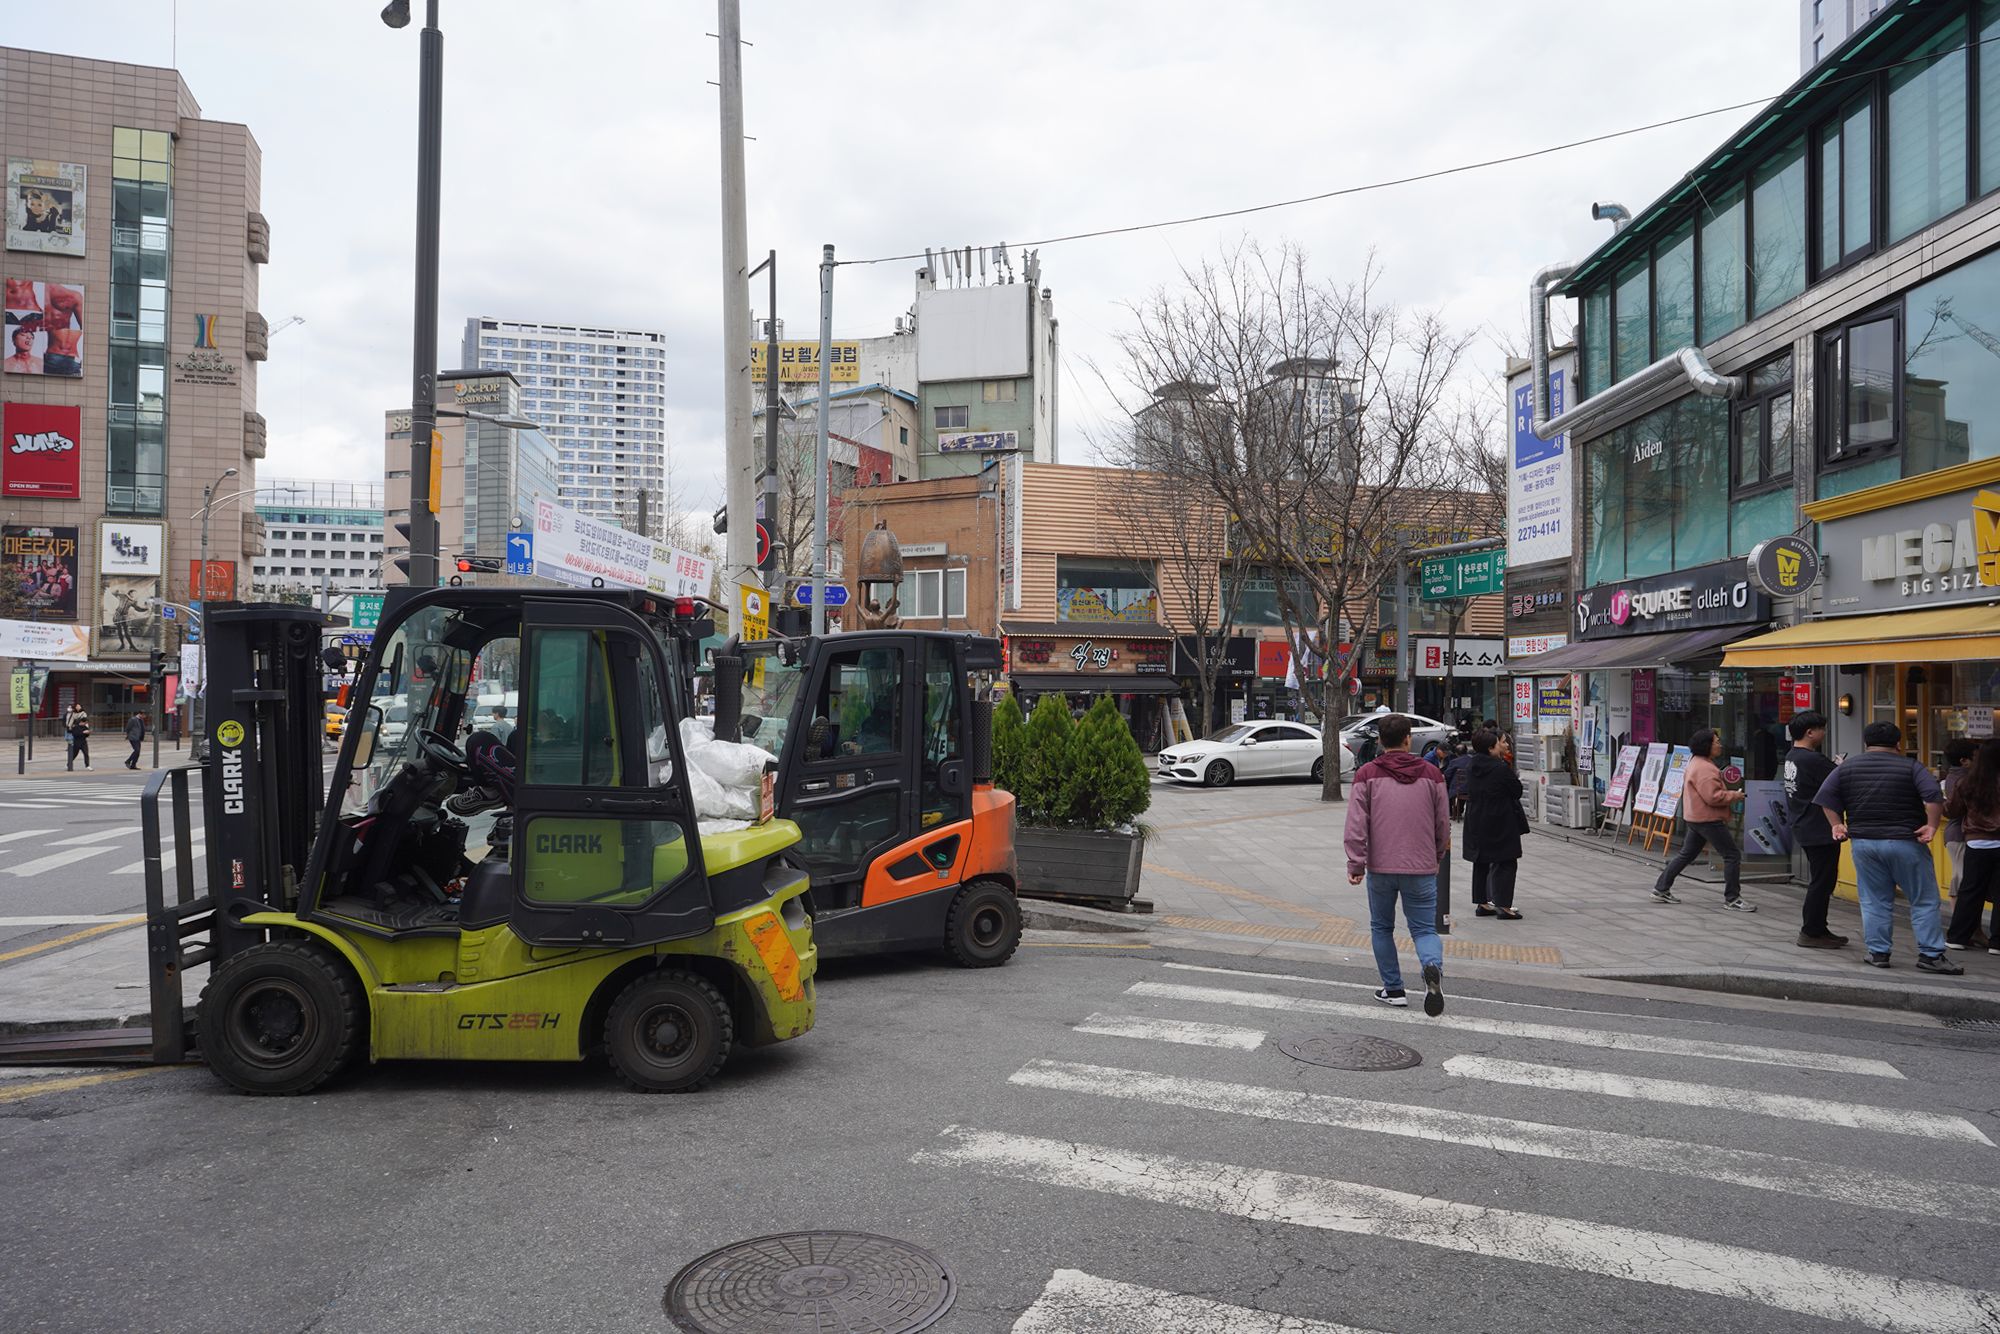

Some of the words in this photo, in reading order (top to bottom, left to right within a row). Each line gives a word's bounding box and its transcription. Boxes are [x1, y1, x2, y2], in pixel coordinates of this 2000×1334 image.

[468, 383, 500, 394] K-POP
[456, 394, 500, 404] RESIDENCE
[11, 431, 74, 454] JUMP
[1633, 440, 1663, 464] Aiden
[1518, 519, 1561, 542] 2279-4141
[1862, 519, 1978, 581] MEGA
[508, 562, 532, 574] 비보호
[1425, 564, 1445, 576] 중구청
[1464, 561, 1489, 575] 충무로역
[1901, 578, 1931, 596] BIG
[1590, 608, 1611, 626] world
[1632, 587, 1693, 619] SQUARE
[1698, 587, 1728, 610] olleh
[1516, 682, 1530, 699] 명함
[1516, 702, 1530, 719] 인쇄
[222, 749, 244, 815] CLARK
[535, 833, 604, 854] CLARK
